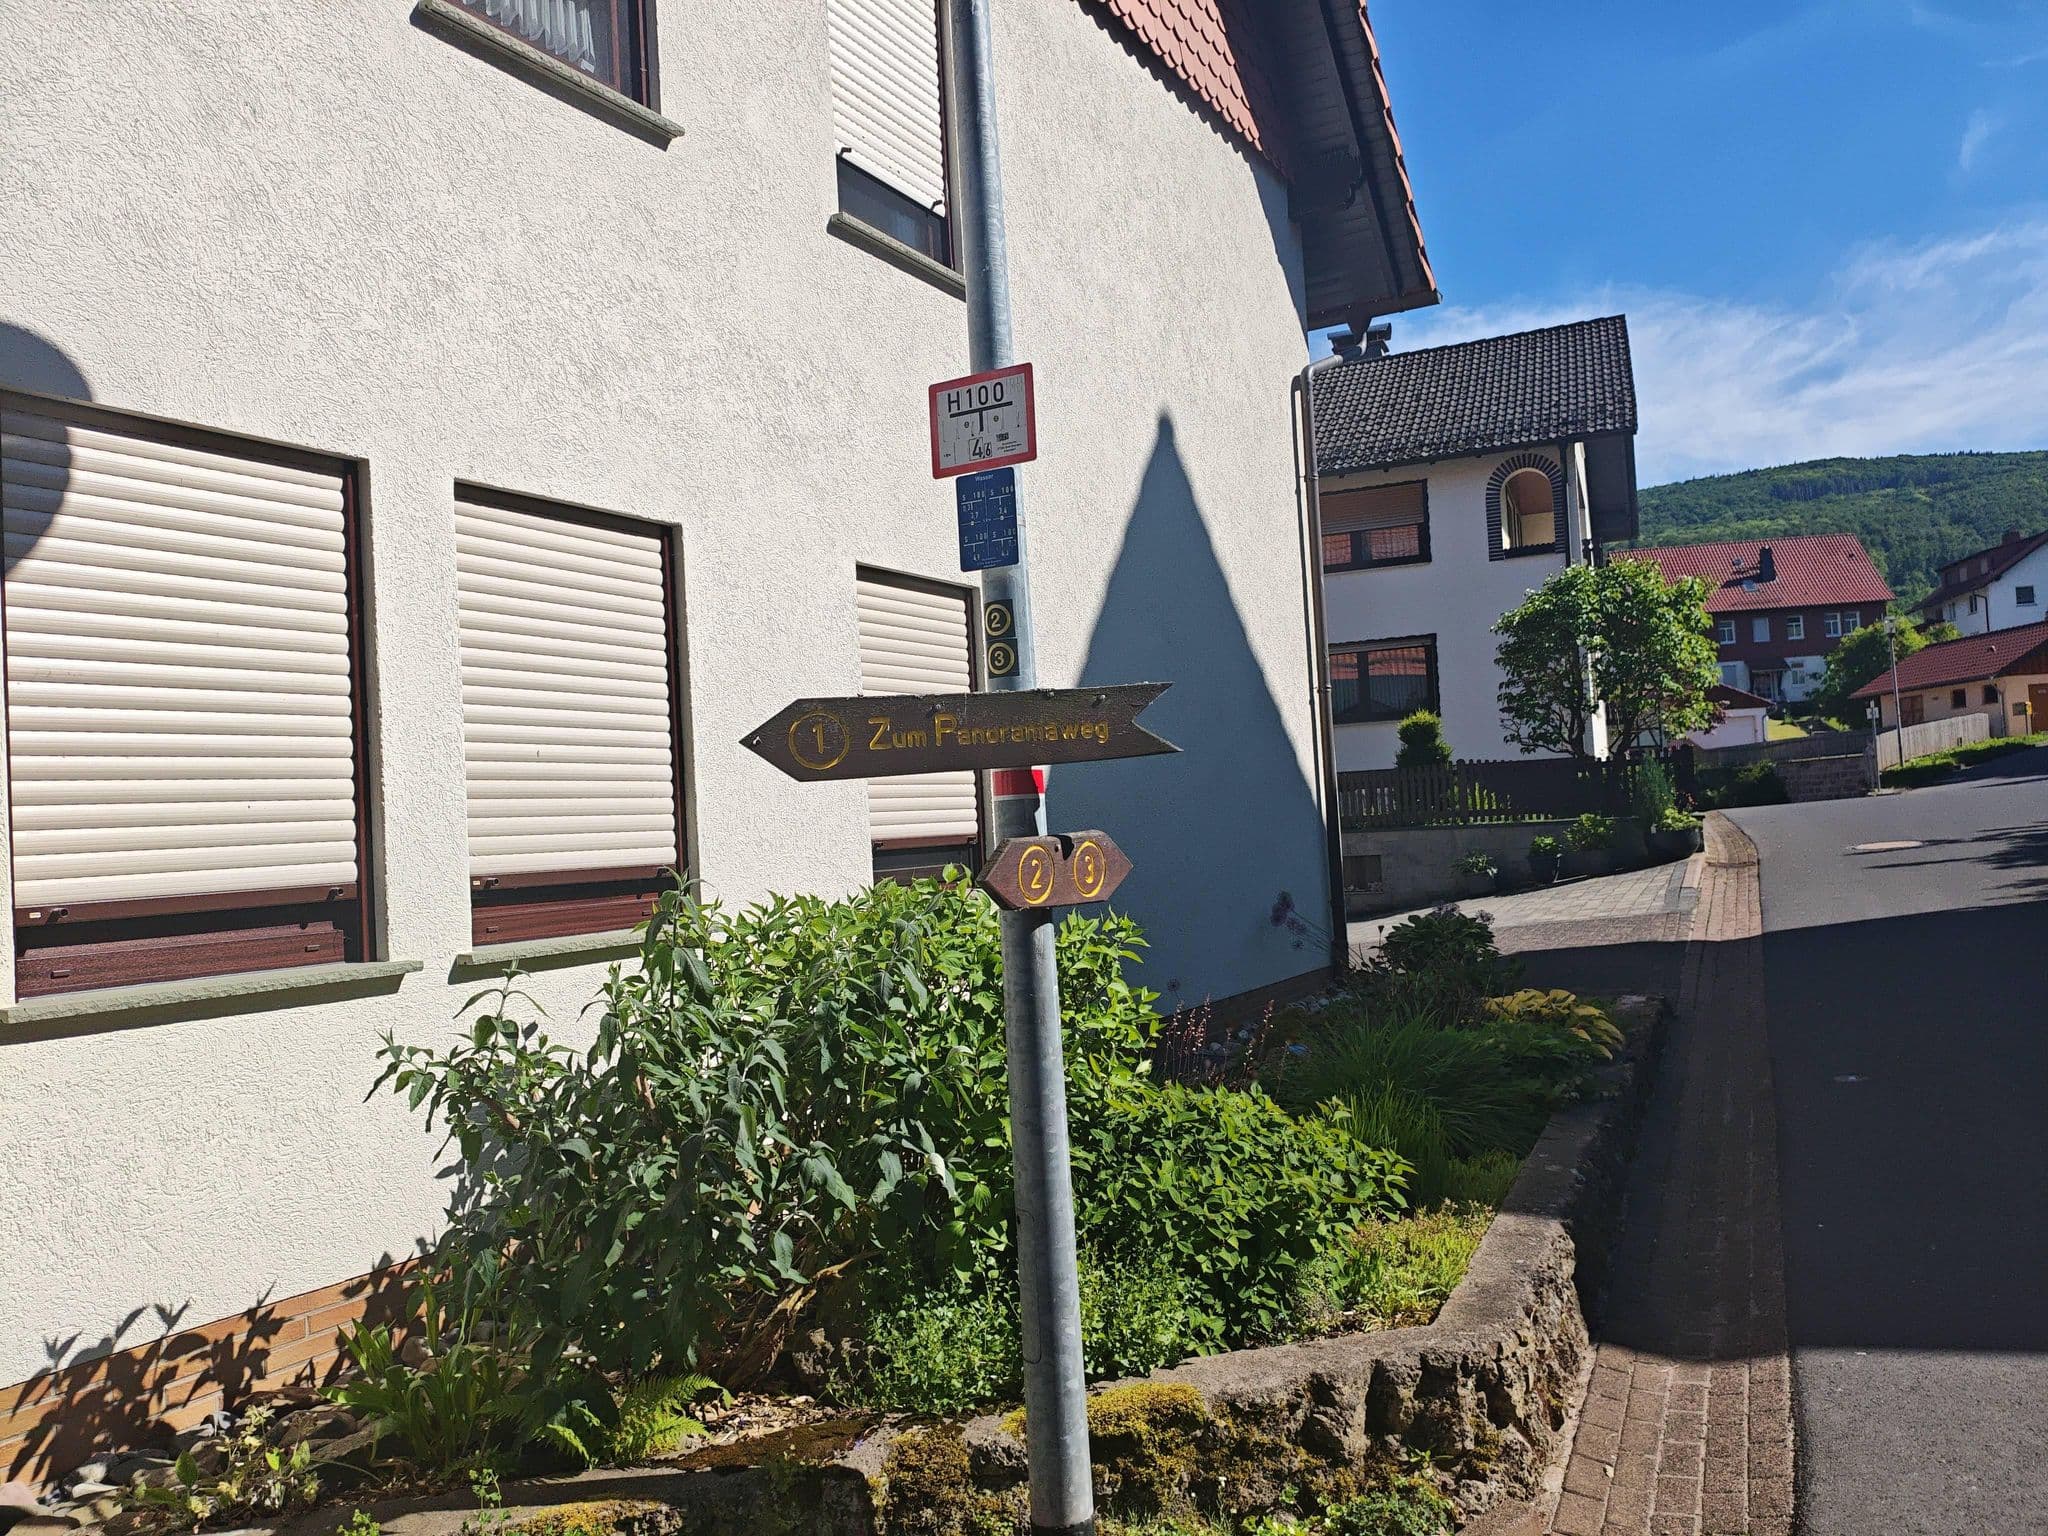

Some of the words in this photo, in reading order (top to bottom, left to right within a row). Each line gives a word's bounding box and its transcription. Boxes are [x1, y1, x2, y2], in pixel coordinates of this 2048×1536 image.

[947, 381, 1004, 413] H100
[991, 612, 1001, 628] 2
[994, 650, 1005, 667] 3
[812, 721, 825, 754] 1
[868, 715, 927, 750] Zum
[933, 711, 1109, 746] Panoramaweg
[1031, 858, 1042, 889] 2
[1084, 854, 1095, 884] 3
